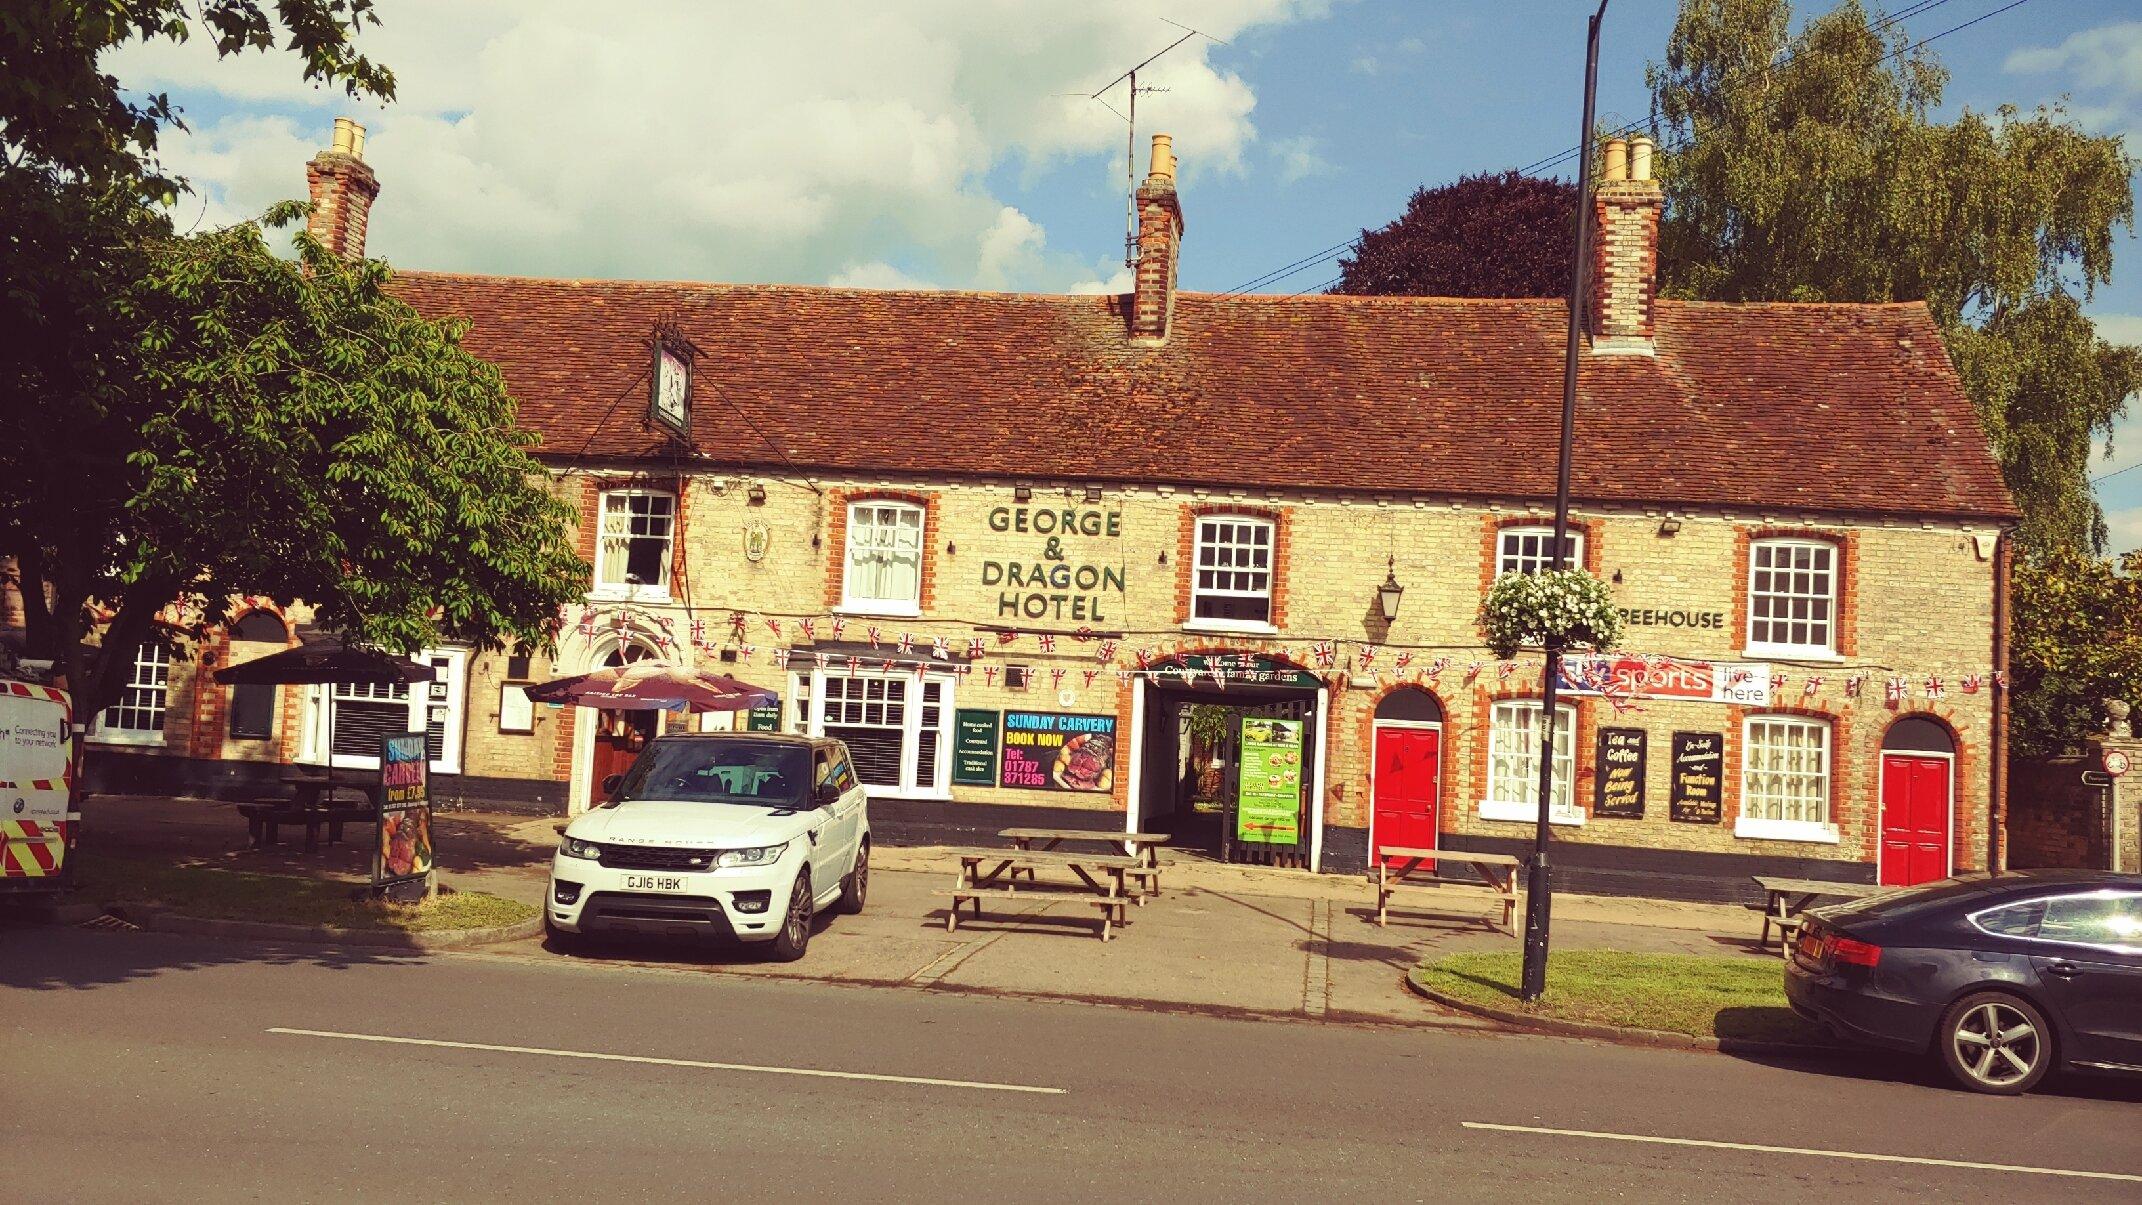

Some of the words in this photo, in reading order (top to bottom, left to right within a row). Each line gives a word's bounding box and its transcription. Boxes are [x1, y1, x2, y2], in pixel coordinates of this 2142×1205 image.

[989, 507, 1121, 536] GEORGE
[1044, 536, 1064, 561] &
[982, 561, 1125, 592] DRAGON
[999, 592, 1105, 621] HOTEL
[1617, 608, 1723, 629] REEHOUSE
[1203, 659, 1236, 667] Wome
[1259, 670, 1298, 682] gardens
[1616, 666, 1707, 692] sports
[1722, 666, 1753, 683] live
[1722, 687, 1764, 701] here
[757, 723, 773, 731] Food
[1007, 714, 1055, 730] SUNDAY
[1058, 716, 1114, 732] CARVERY
[15, 725, 45, 738] Connecting
[46, 730, 56, 739] you
[1006, 731, 1035, 746] BOOK
[1037, 733, 1063, 747] NOW
[1606, 732, 1626, 746] Tea
[15, 736, 21, 744] to
[23, 738, 34, 748] your
[36, 739, 56, 748] network
[1005, 748, 1023, 760] Tel:
[1606, 748, 1639, 763] Coffee
[1004, 760, 1039, 772] 01787
[1604, 778, 1636, 794] Being
[1679, 772, 1716, 786] Function
[388, 787, 405, 801] from
[1686, 784, 1707, 796] Room
[1604, 791, 1640, 807] Served
[627, 876, 654, 889] GJ16
[657, 878, 681, 890] HBK
